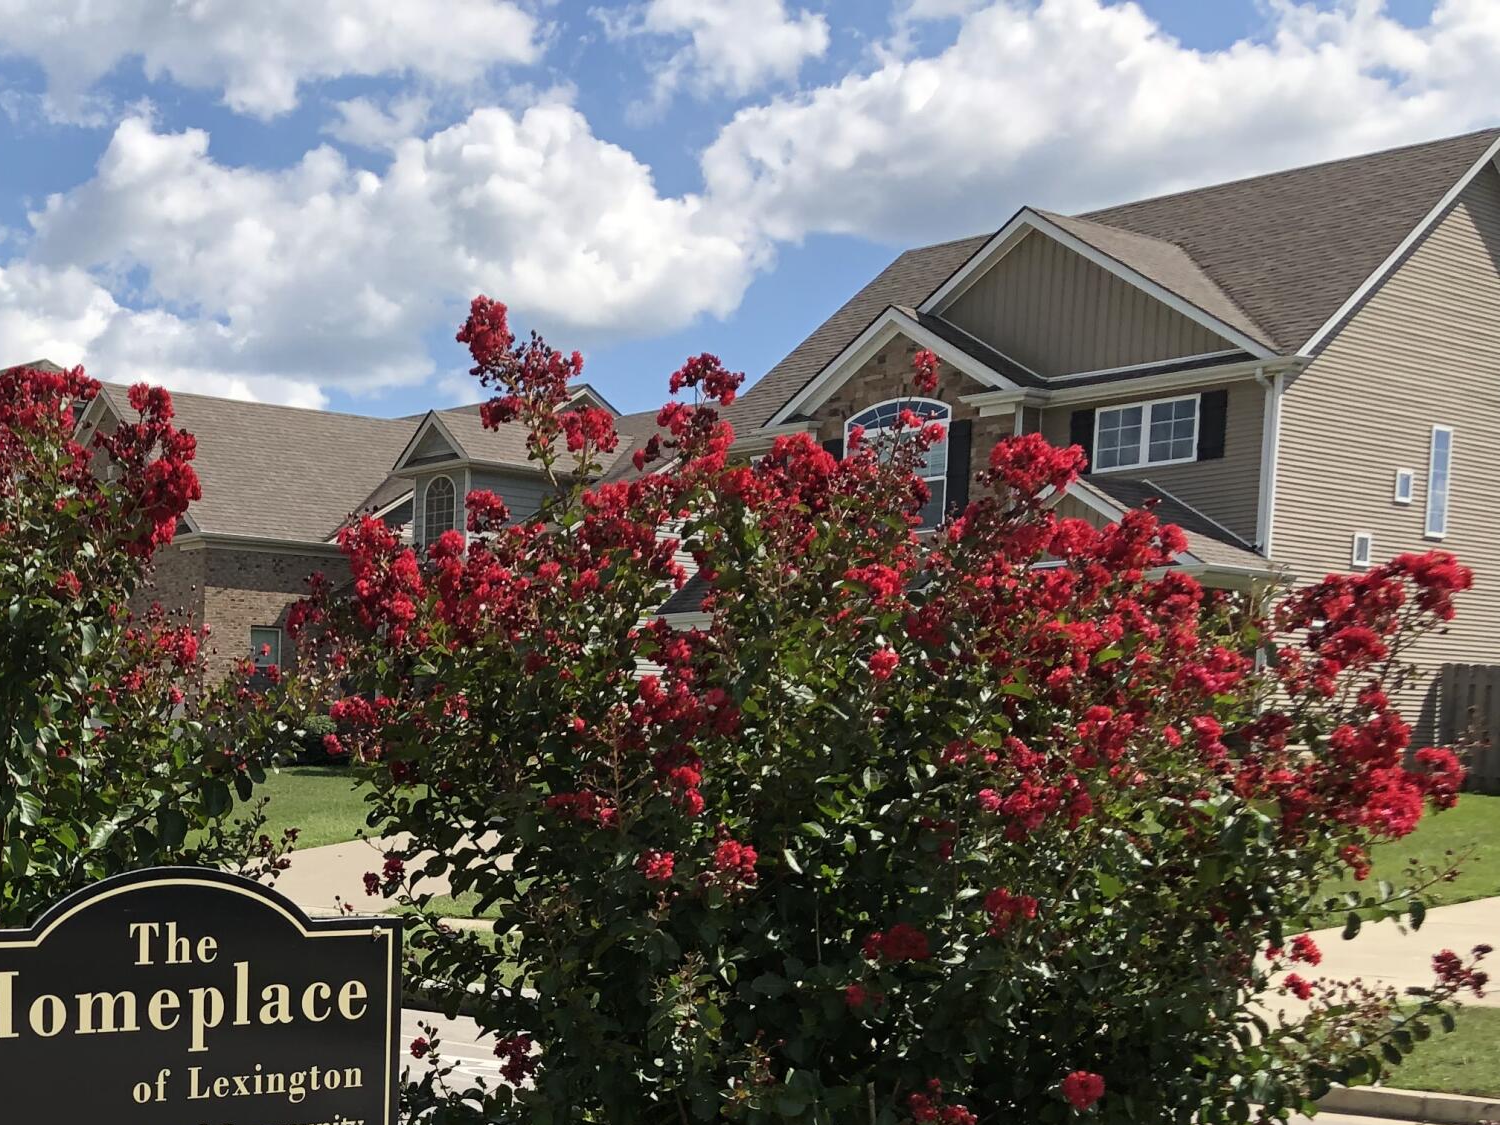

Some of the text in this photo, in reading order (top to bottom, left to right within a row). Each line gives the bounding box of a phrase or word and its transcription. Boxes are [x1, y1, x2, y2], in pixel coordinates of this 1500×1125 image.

[129, 921, 218, 966] The
[132, 1063, 363, 1104] of Lexington
